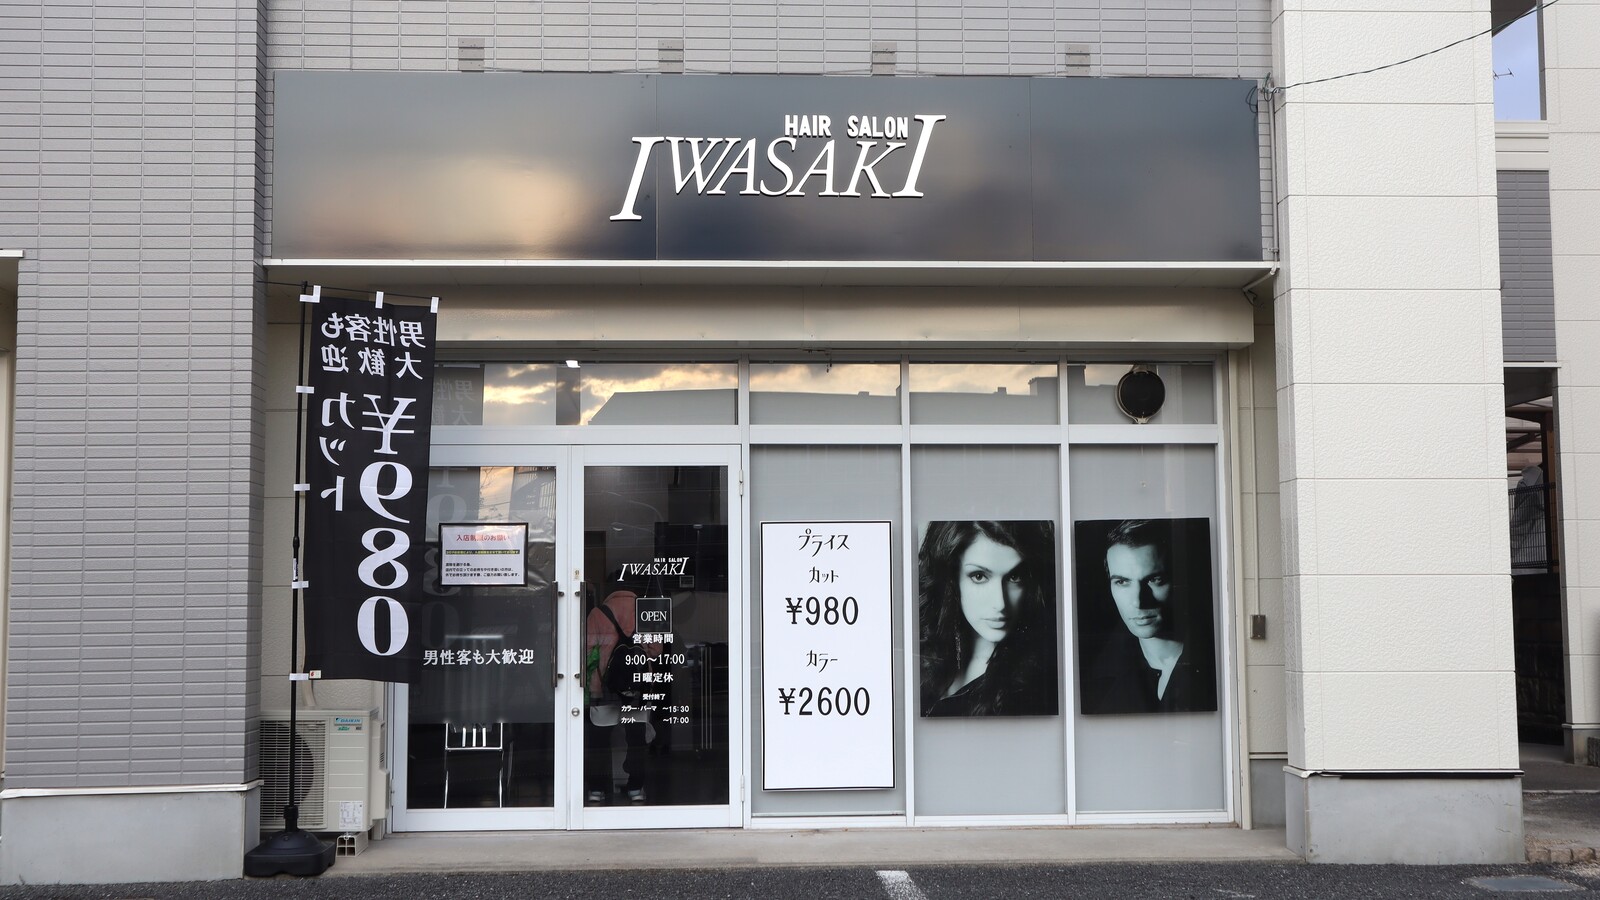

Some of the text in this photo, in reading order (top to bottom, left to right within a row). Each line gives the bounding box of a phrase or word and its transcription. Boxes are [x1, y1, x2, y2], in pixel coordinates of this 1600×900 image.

[784, 114, 909, 139] HAIR SALON
[609, 114, 947, 221] IWASAKI
[798, 528, 850, 557] プライス
[617, 556, 690, 582] IWASAKI
[808, 566, 839, 584] カット
[640, 610, 667, 622] OPEN
[785, 595, 859, 626] ¥980
[632, 633, 674, 644] 営業時間
[423, 648, 534, 666] 男性客も大歓迎
[806, 649, 839, 673] カラー
[632, 672, 674, 683] 日曜定休
[642, 693, 666, 701] 受付終了
[777, 686, 871, 717] ¥2600
[620, 716, 636, 724] カット
